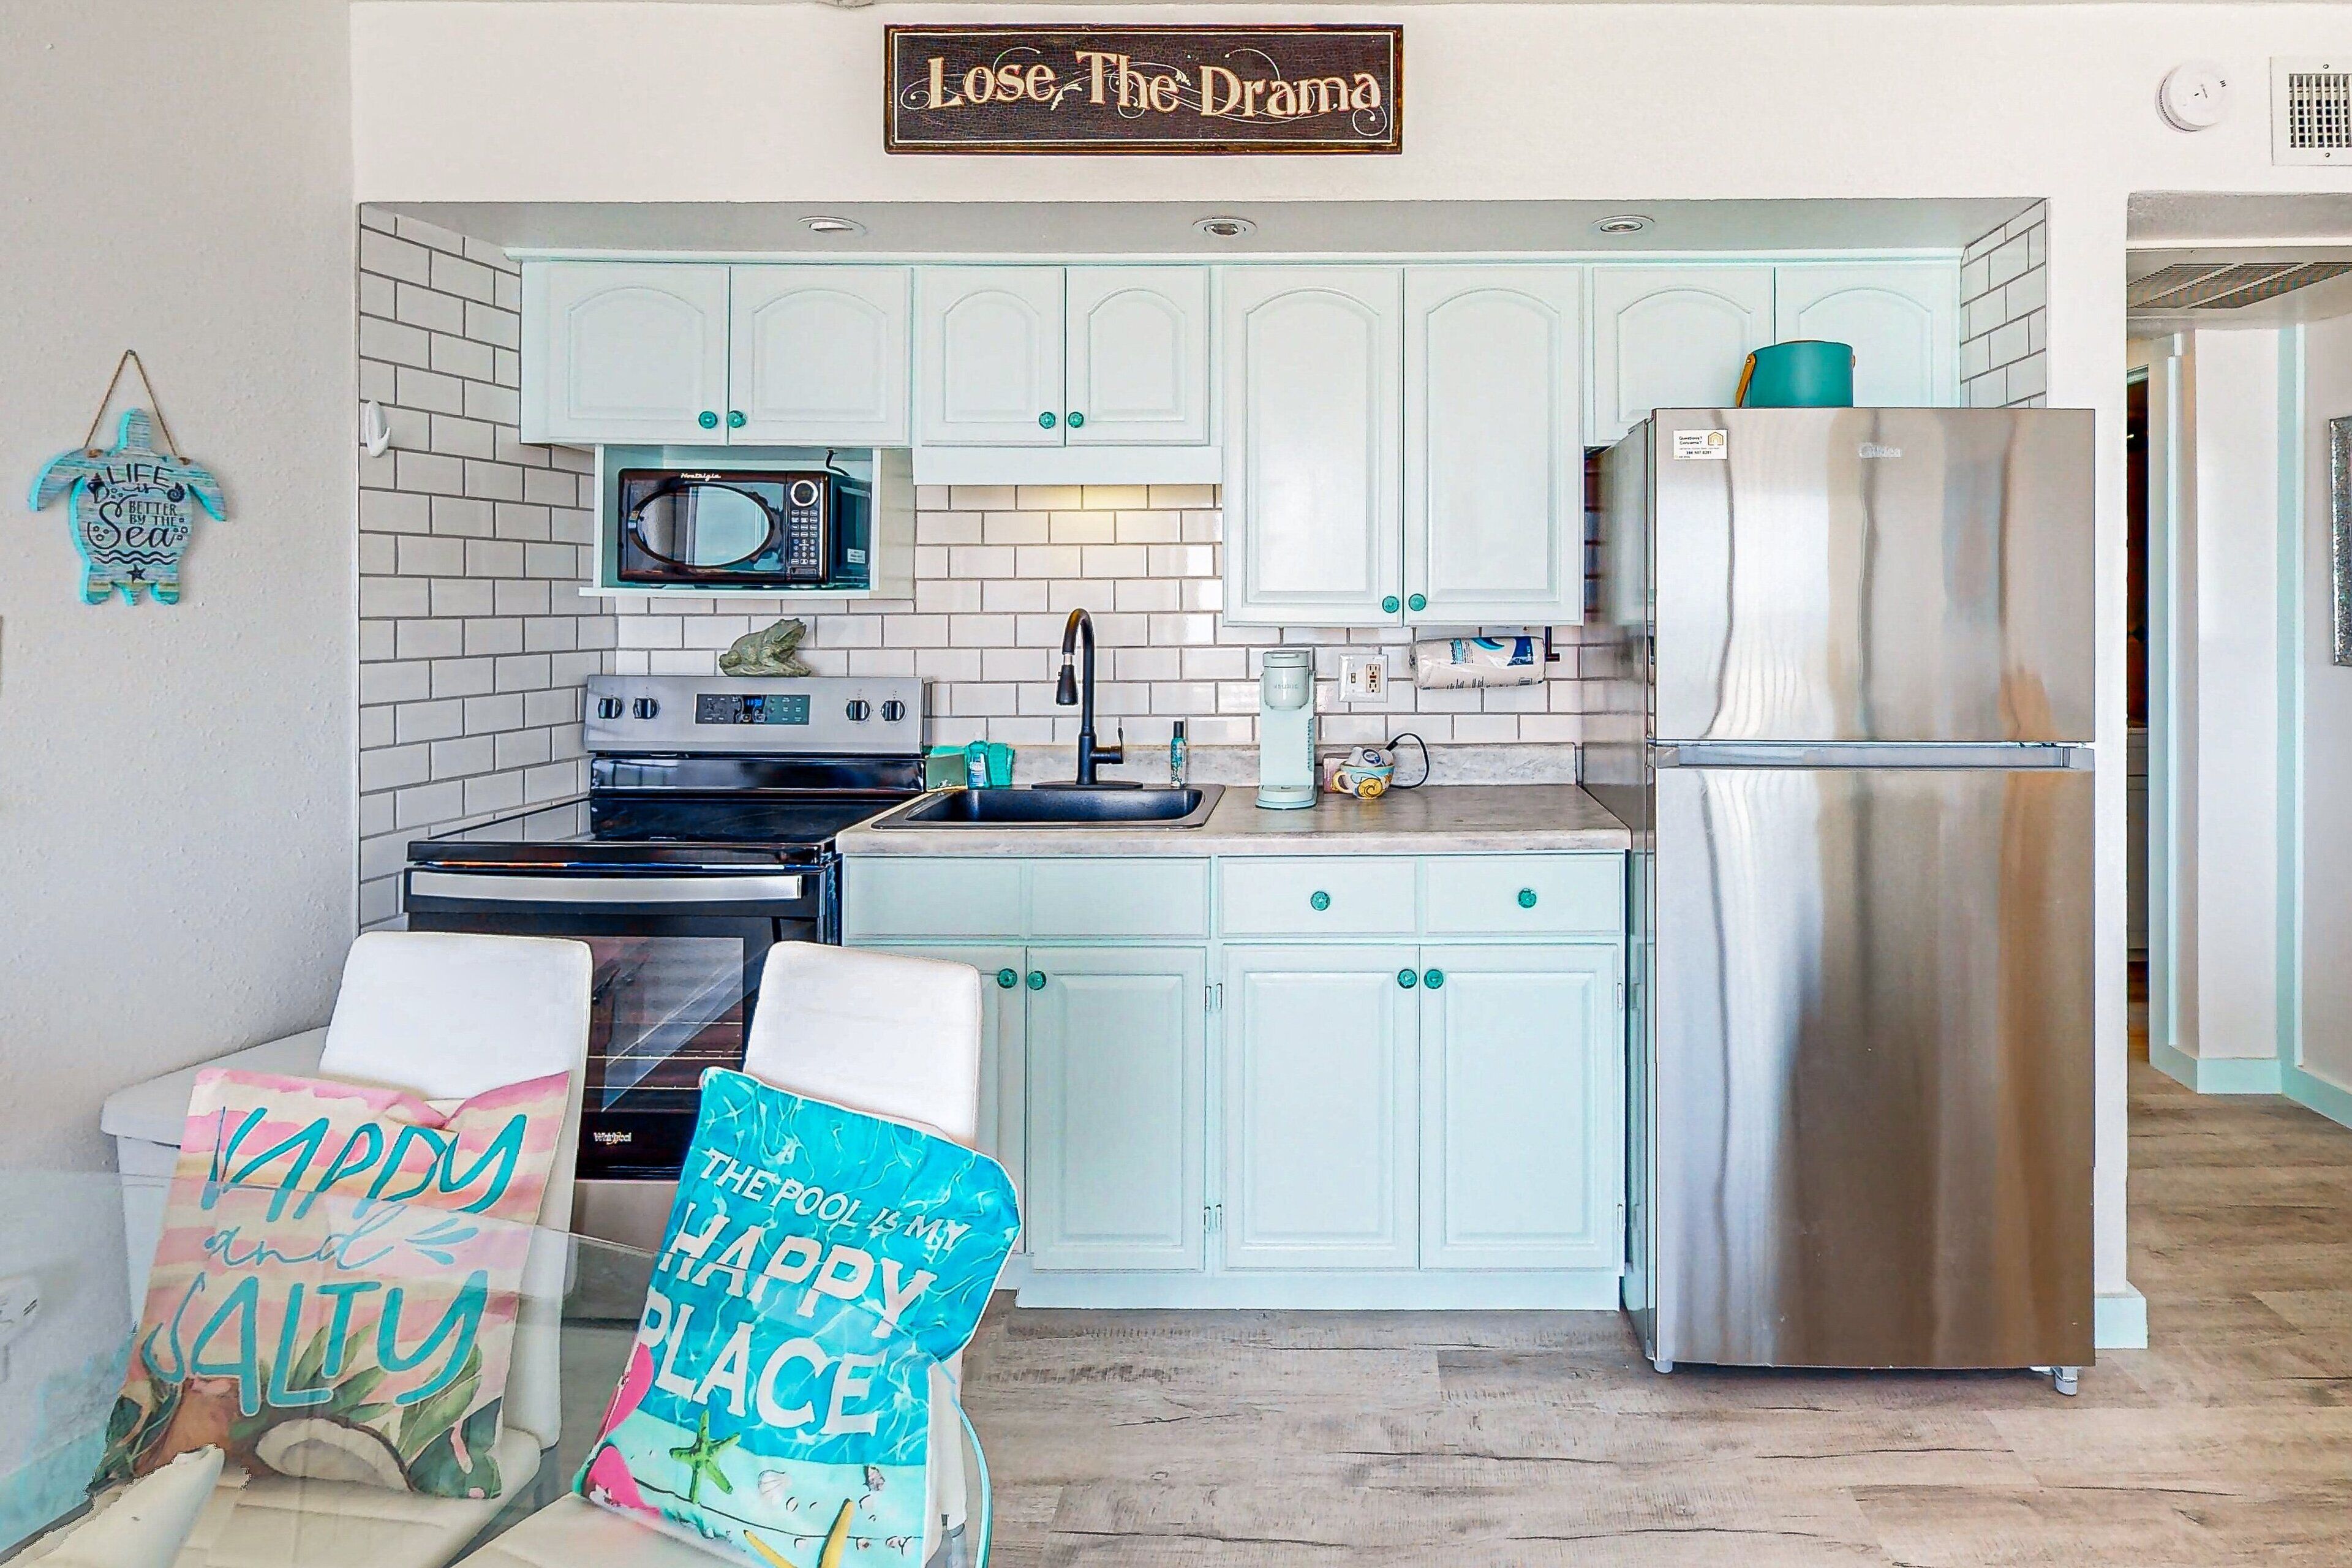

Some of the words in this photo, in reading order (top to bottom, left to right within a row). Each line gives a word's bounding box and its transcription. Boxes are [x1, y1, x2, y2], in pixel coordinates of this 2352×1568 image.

[924, 56, 1059, 110] Lose
[1076, 50, 1180, 114] The
[1199, 65, 1382, 117] Drama
[107, 463, 174, 488] LIFE
[680, 473, 722, 482] Nostalgia
[87, 494, 176, 550] Sea
[129, 500, 178, 516] BETTER
[129, 514, 146, 525] BY
[153, 516, 177, 526] THE
[594, 1132, 631, 1145] Whirlpool
[699, 1147, 774, 1201] THE
[773, 1177, 861, 1227] POOL
[868, 1207, 899, 1235] IS
[908, 1214, 973, 1254] MY
[203, 1202, 408, 1270] and
[658, 1202, 940, 1338] HAPPY
[142, 1269, 488, 1417] SALTY
[636, 1286, 888, 1436] PLACE
